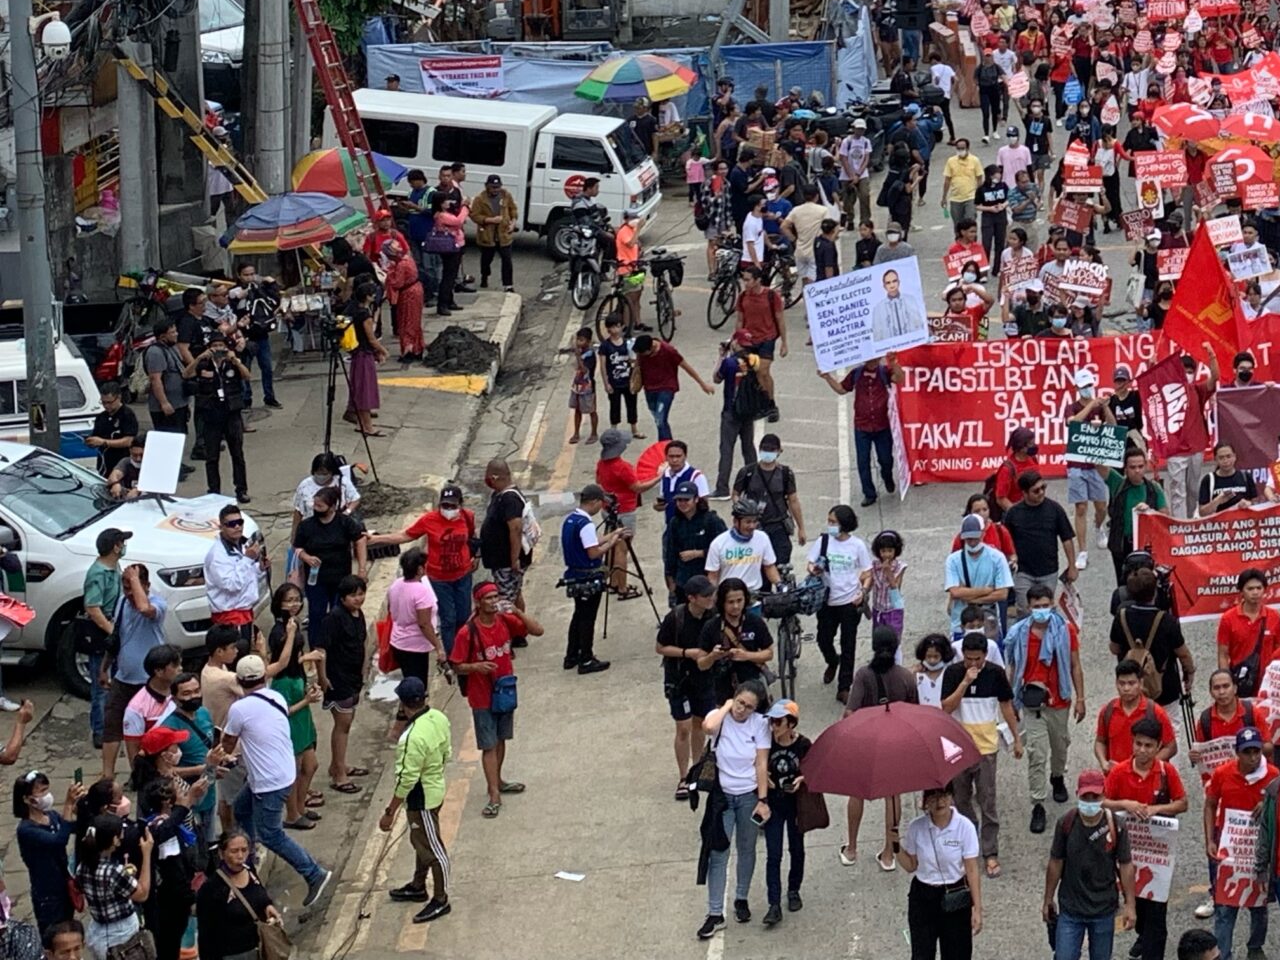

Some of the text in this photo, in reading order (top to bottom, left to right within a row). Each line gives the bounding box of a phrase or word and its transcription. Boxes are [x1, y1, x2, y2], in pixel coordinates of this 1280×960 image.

[1063, 259, 1109, 281] MARCOS
[815, 287, 872, 308] NEWLY ELECTED
[838, 298, 870, 314] DANIEL
[820, 308, 870, 329] RONQUILLO
[827, 320, 866, 338] MACTIRA
[973, 339, 1092, 368] ISKOLAR
[1114, 333, 1155, 362] NG
[901, 365, 1037, 393] IPAGSILBI
[994, 391, 1030, 420] SA
[903, 420, 994, 451] TAKWIL
[1101, 425, 1117, 439] ALL
[930, 457, 973, 471] SINING
[1169, 522, 1229, 534] IPAGLABAN
[1232, 519, 1255, 530] ANG
[1184, 532, 1231, 544] IBASURA
[1234, 530, 1257, 541] ANG
[725, 546, 753, 560] bike
[1171, 544, 1213, 556] DAGDAG
